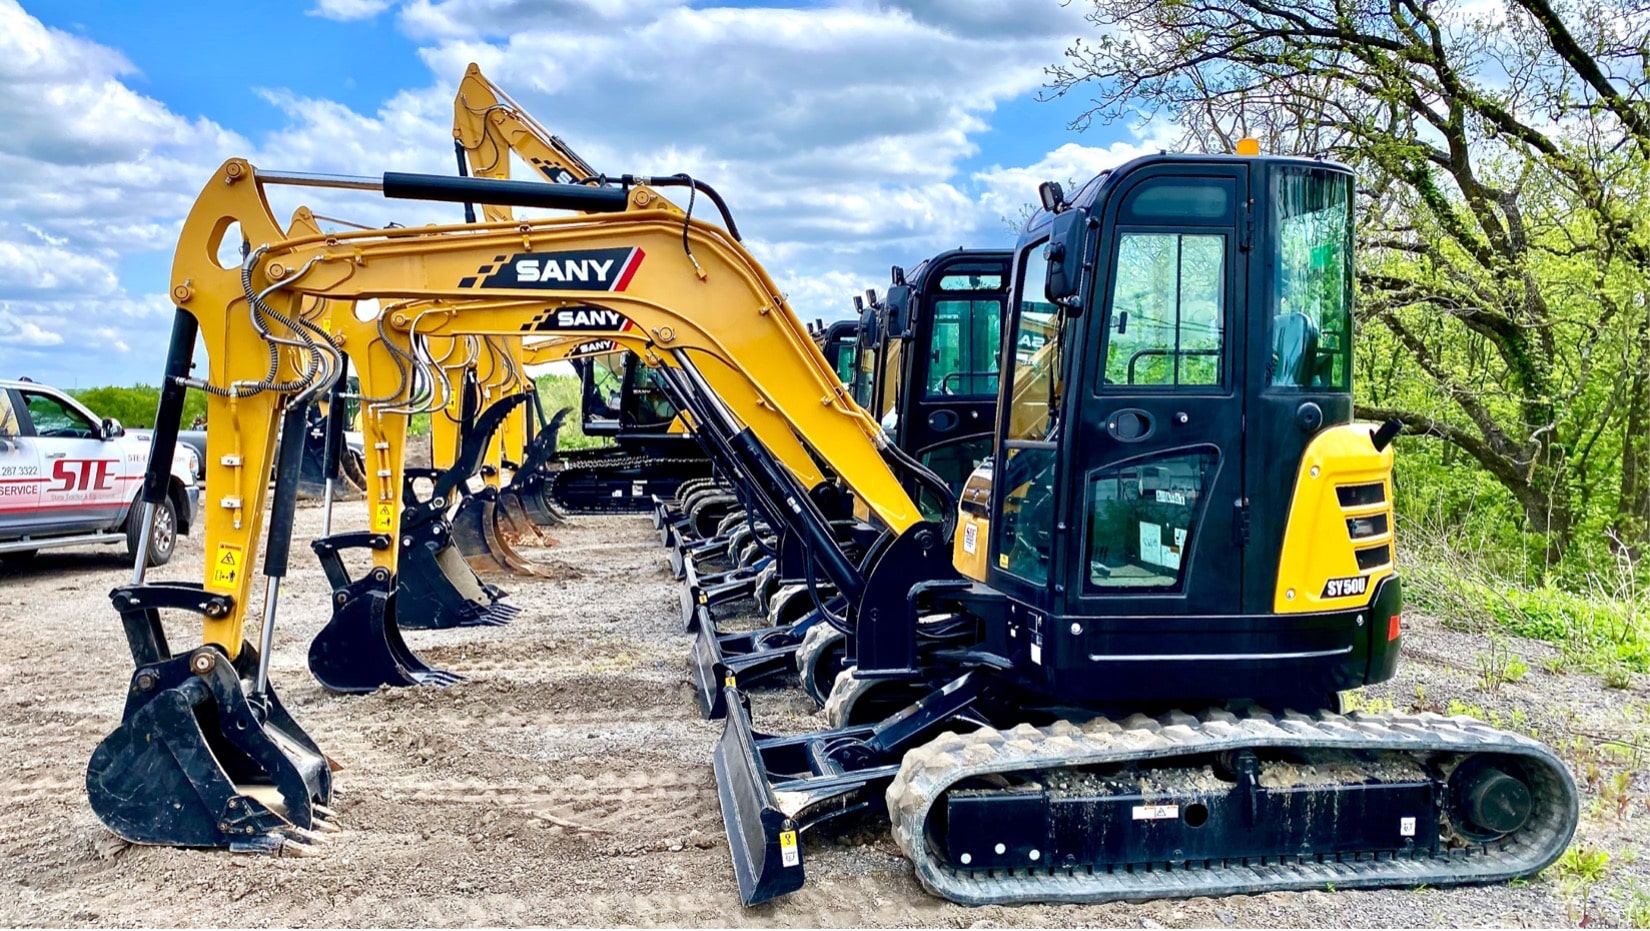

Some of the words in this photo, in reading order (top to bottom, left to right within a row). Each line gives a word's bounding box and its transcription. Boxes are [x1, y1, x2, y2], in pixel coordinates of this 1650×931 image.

[516, 259, 615, 282] SANY
[558, 310, 620, 326] SANY
[580, 340, 611, 353] SANY
[47, 459, 120, 492] STE
[0, 485, 38, 496] SERVICE
[1327, 577, 1366, 596] SY50U
